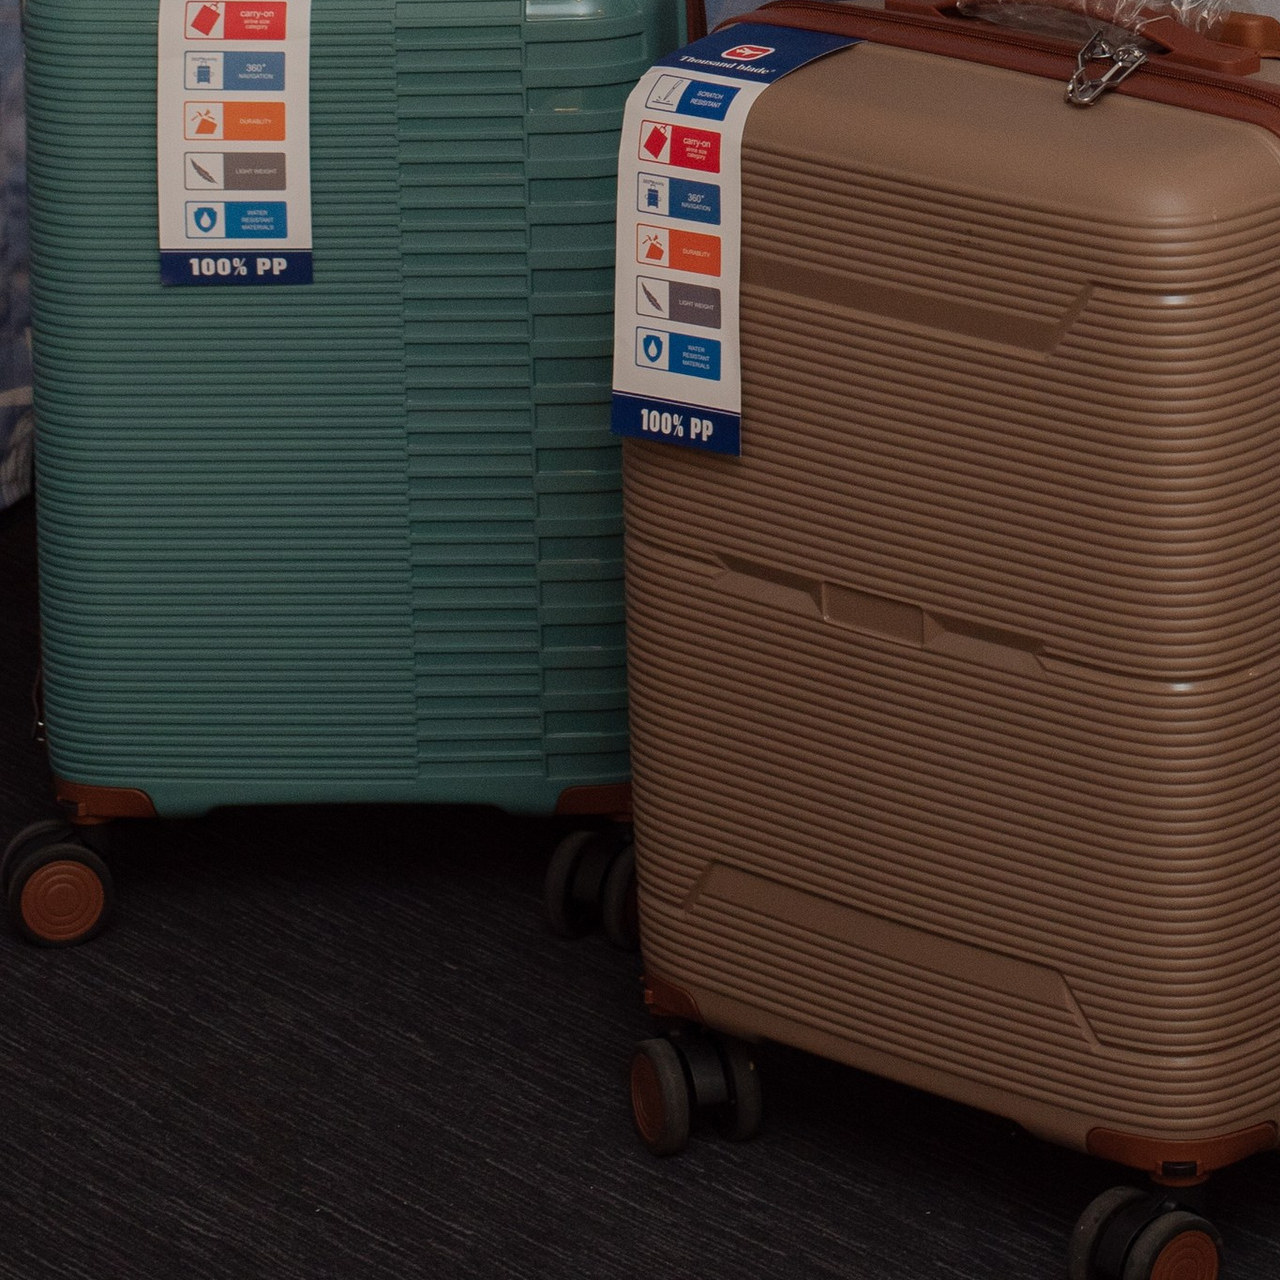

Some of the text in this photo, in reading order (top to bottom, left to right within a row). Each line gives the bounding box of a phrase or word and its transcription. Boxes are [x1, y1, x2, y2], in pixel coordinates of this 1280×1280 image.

[240, 10, 275, 19] carry-on
[680, 55, 737, 69] Thousand
[682, 137, 711, 149] carry-on
[189, 257, 288, 276] 100% PP
[640, 408, 714, 442] 100% PP
